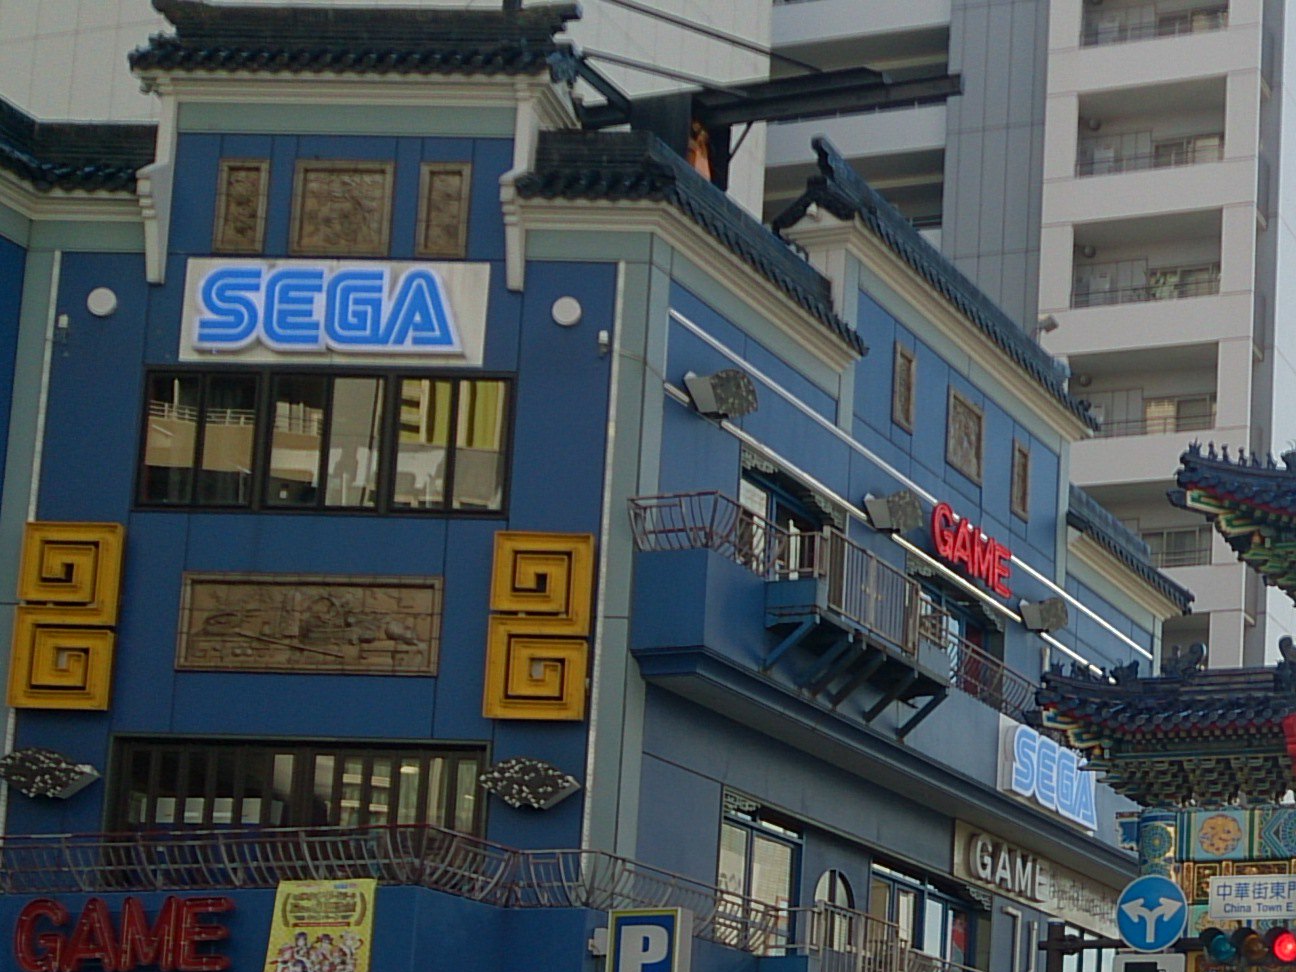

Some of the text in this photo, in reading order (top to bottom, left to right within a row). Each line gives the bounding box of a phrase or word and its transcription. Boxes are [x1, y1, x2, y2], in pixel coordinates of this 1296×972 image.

[195, 265, 459, 348] SEGA
[931, 501, 1013, 599] GAME
[1012, 723, 1098, 831] SEGA
[970, 832, 1051, 901] GAME
[1223, 902, 1251, 914] China
[1257, 902, 1282, 913] Town
